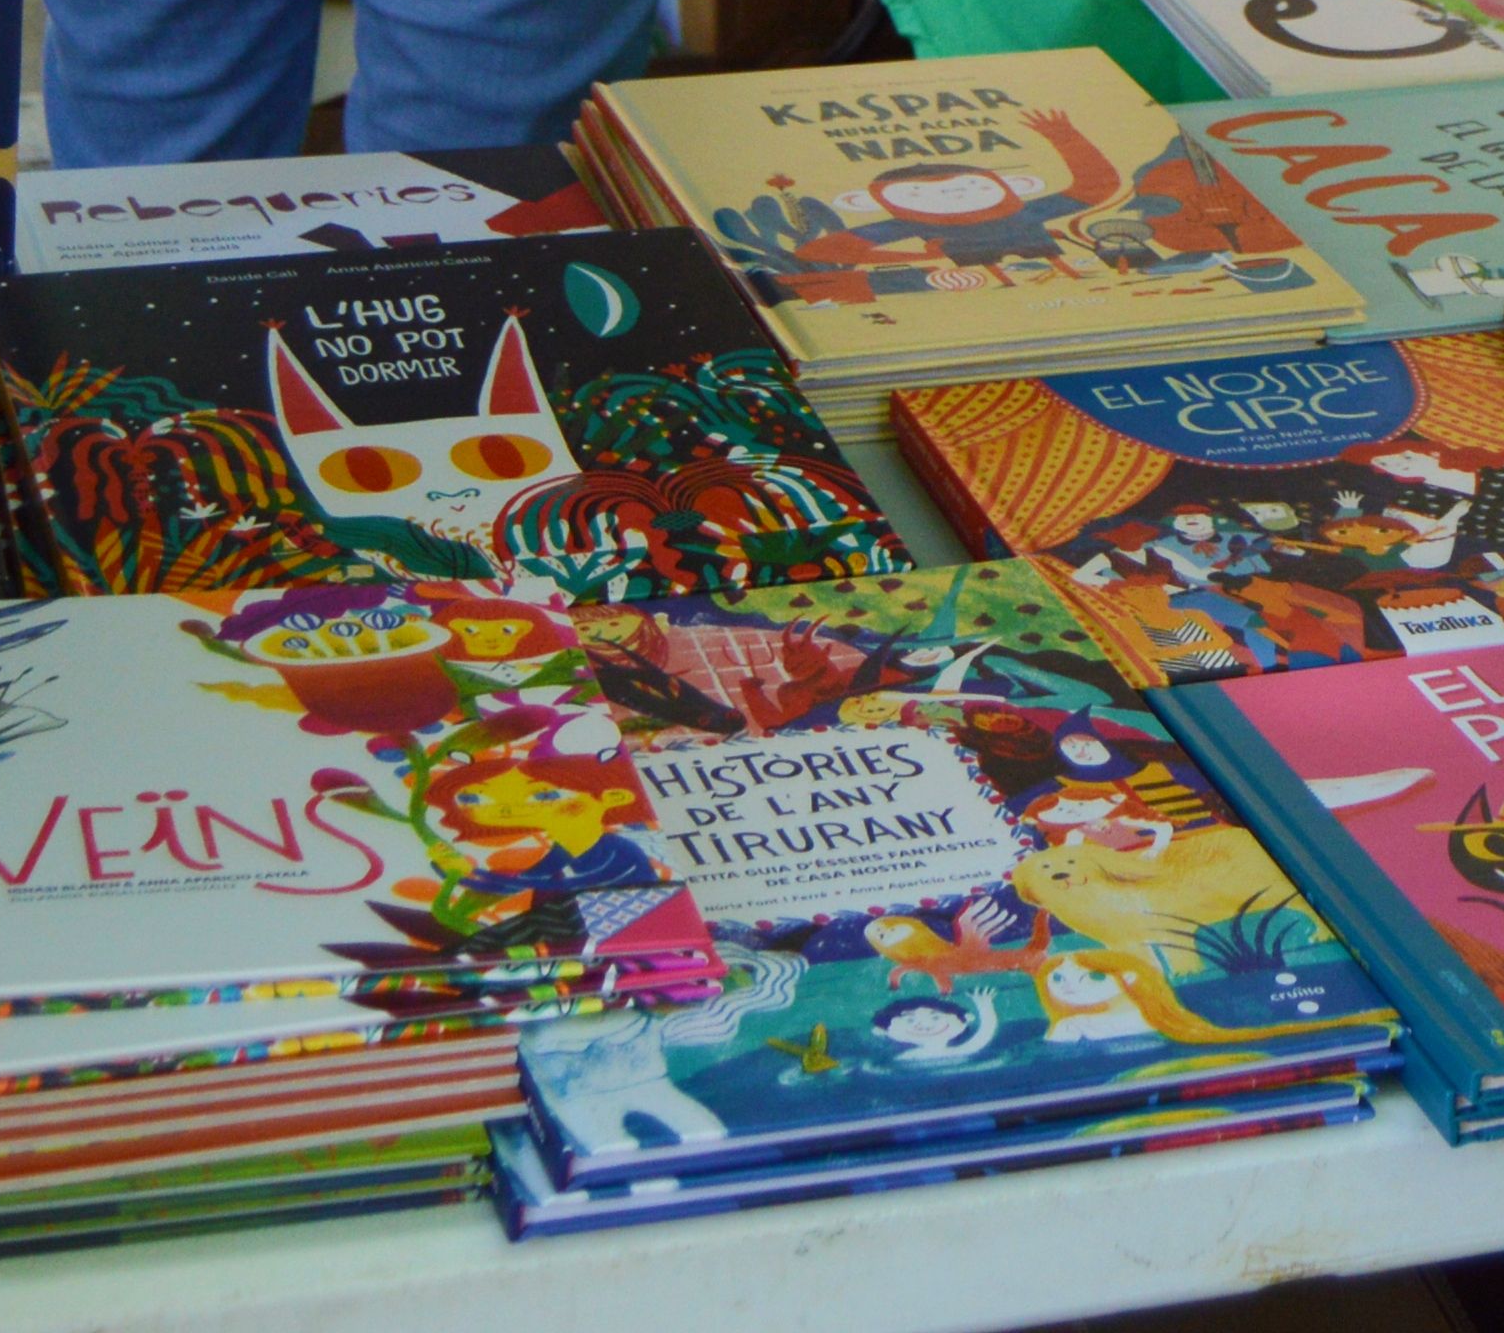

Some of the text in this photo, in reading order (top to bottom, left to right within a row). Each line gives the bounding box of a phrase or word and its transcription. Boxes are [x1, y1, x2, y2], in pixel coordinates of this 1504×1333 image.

[760, 88, 1023, 126] KASPAR
[823, 116, 1000, 139] NUNCA ACABA
[1437, 119, 1481, 142] EL
[835, 130, 1023, 162] NADA
[1421, 150, 1473, 175] DE
[1205, 109, 1500, 257] CACA
[40, 183, 478, 225] Rebequeries
[59, 251, 103, 261] Anna
[112, 246, 181, 260] Aparicio
[326, 264, 368, 275] Anna
[373, 258, 439, 273] Aparicio
[305, 294, 446, 329] L'HUG
[314, 327, 464, 358] NO POT
[338, 356, 461, 385] DORMIR
[1092, 360, 1390, 410] EL NOSTRE
[1177, 387, 1378, 436] CIRC
[1205, 445, 1247, 457] Anna
[1252, 437, 1317, 453] Aparicio
[1241, 432, 1280, 443] Fran
[686, 803, 745, 827] DE
[744, 862, 792, 877] GUIA
[764, 859, 928, 888] DE CASA NOSTRA
[849, 885, 885, 895] Anna
[888, 876, 946, 893] Aparicio
